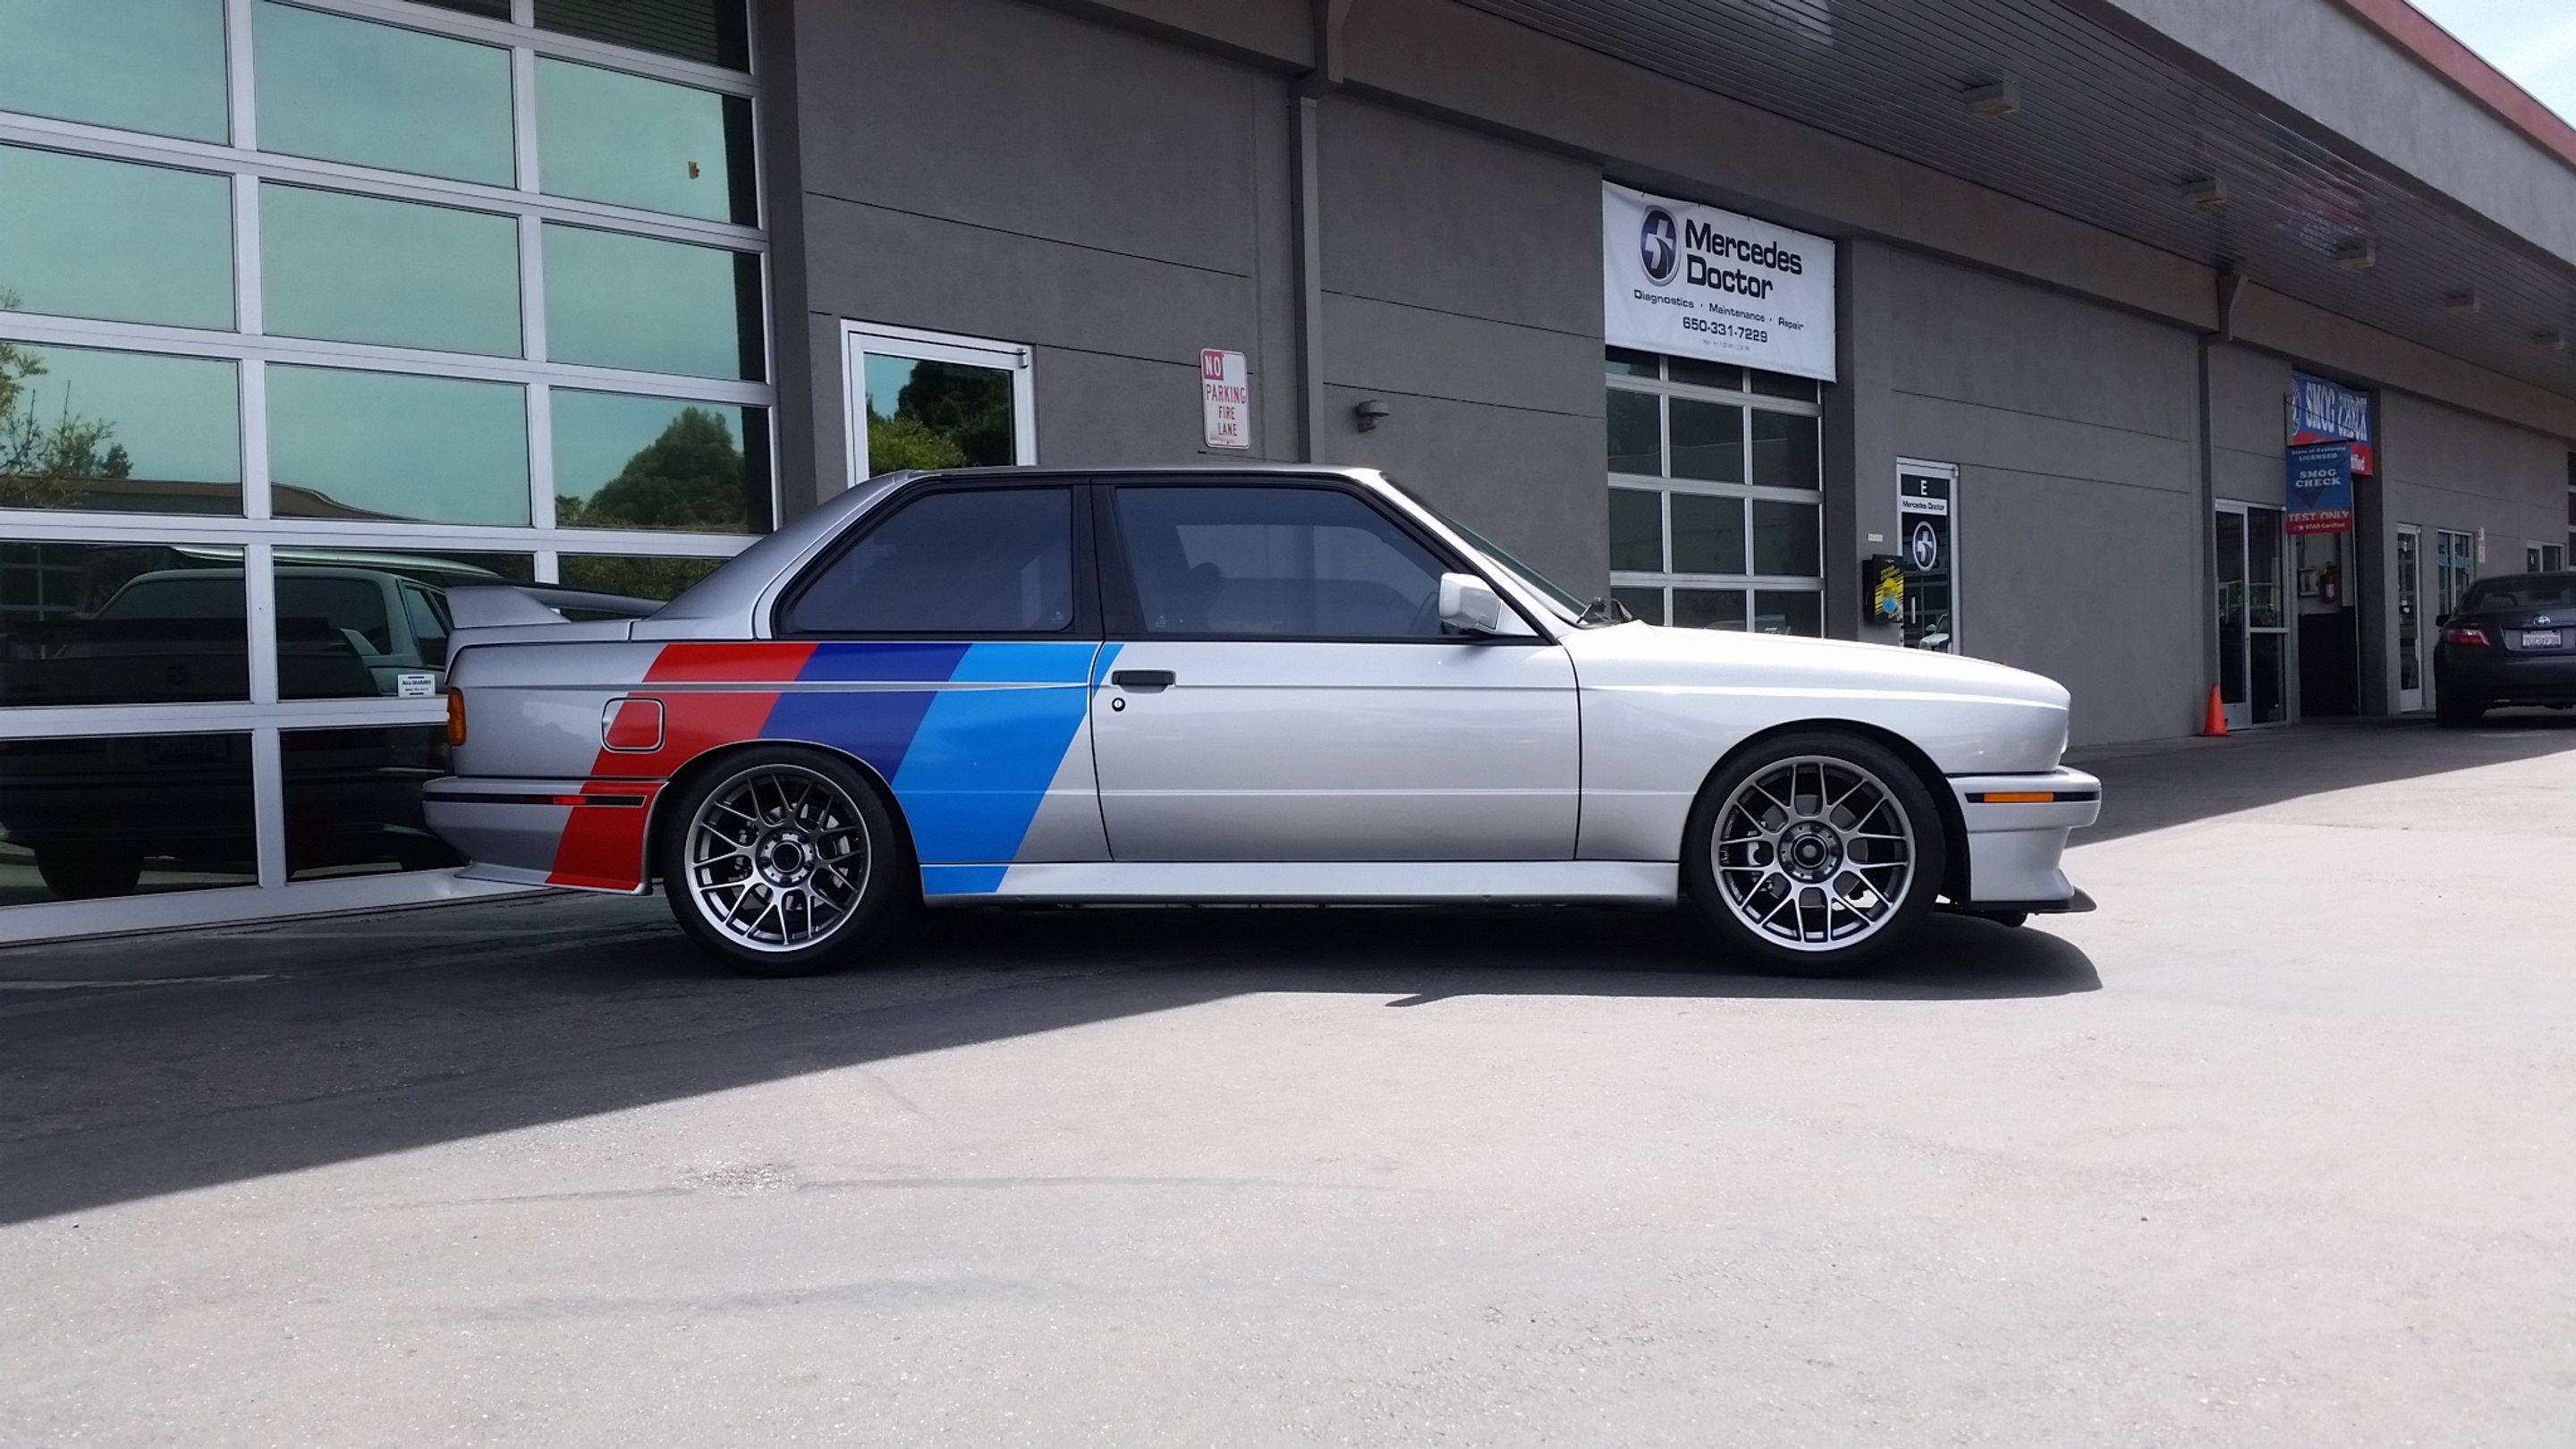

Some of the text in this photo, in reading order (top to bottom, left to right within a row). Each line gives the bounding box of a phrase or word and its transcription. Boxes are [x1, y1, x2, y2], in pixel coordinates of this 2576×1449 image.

[1685, 219, 1802, 275] Mercedes
[1687, 255, 1773, 299] Doctor
[1633, 289, 1804, 331] Diagnostics Maintenance Repair
[1205, 355, 1222, 377] NO
[1206, 384, 1246, 403] PARKING
[1218, 406, 1235, 419] FIRE
[2306, 382, 2335, 433] SMOG
[1217, 423, 1237, 436] LANE
[2299, 453, 2338, 462] LICENSED
[2300, 468, 2337, 479] SMOG
[1920, 479, 1928, 496] E
[2295, 477, 2342, 488] CHECK
[1902, 500, 1927, 510] Mercedes
[2288, 511, 2349, 522] TEST ONLY
